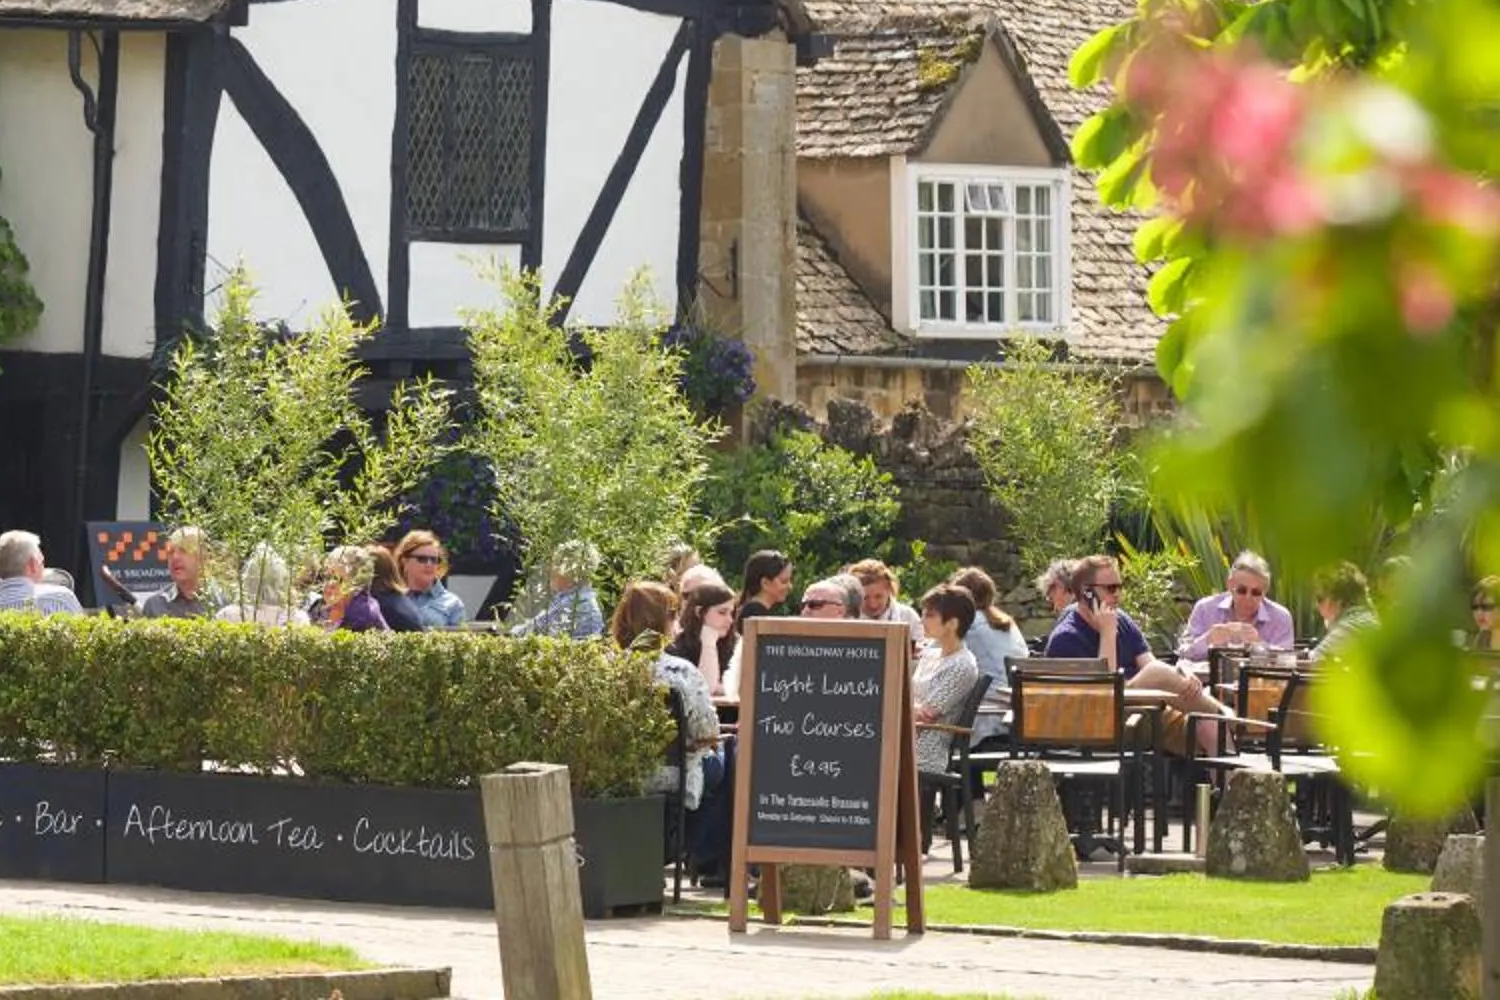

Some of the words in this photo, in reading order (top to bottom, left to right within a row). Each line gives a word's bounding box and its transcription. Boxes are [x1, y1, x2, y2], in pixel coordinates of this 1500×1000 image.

[765, 645, 785, 657] THE
[787, 645, 844, 658] BROADWAY
[845, 647, 879, 659] HOTEL
[761, 671, 814, 702] Light
[822, 673, 879, 697] Lunch
[758, 715, 795, 735] Two
[802, 712, 875, 738] Courses
[790, 754, 842, 778] £9.95
[35, 801, 83, 836] Bar
[123, 803, 258, 845] Afternoon
[266, 817, 324, 850] Tea
[353, 816, 476, 861] Cocktails
